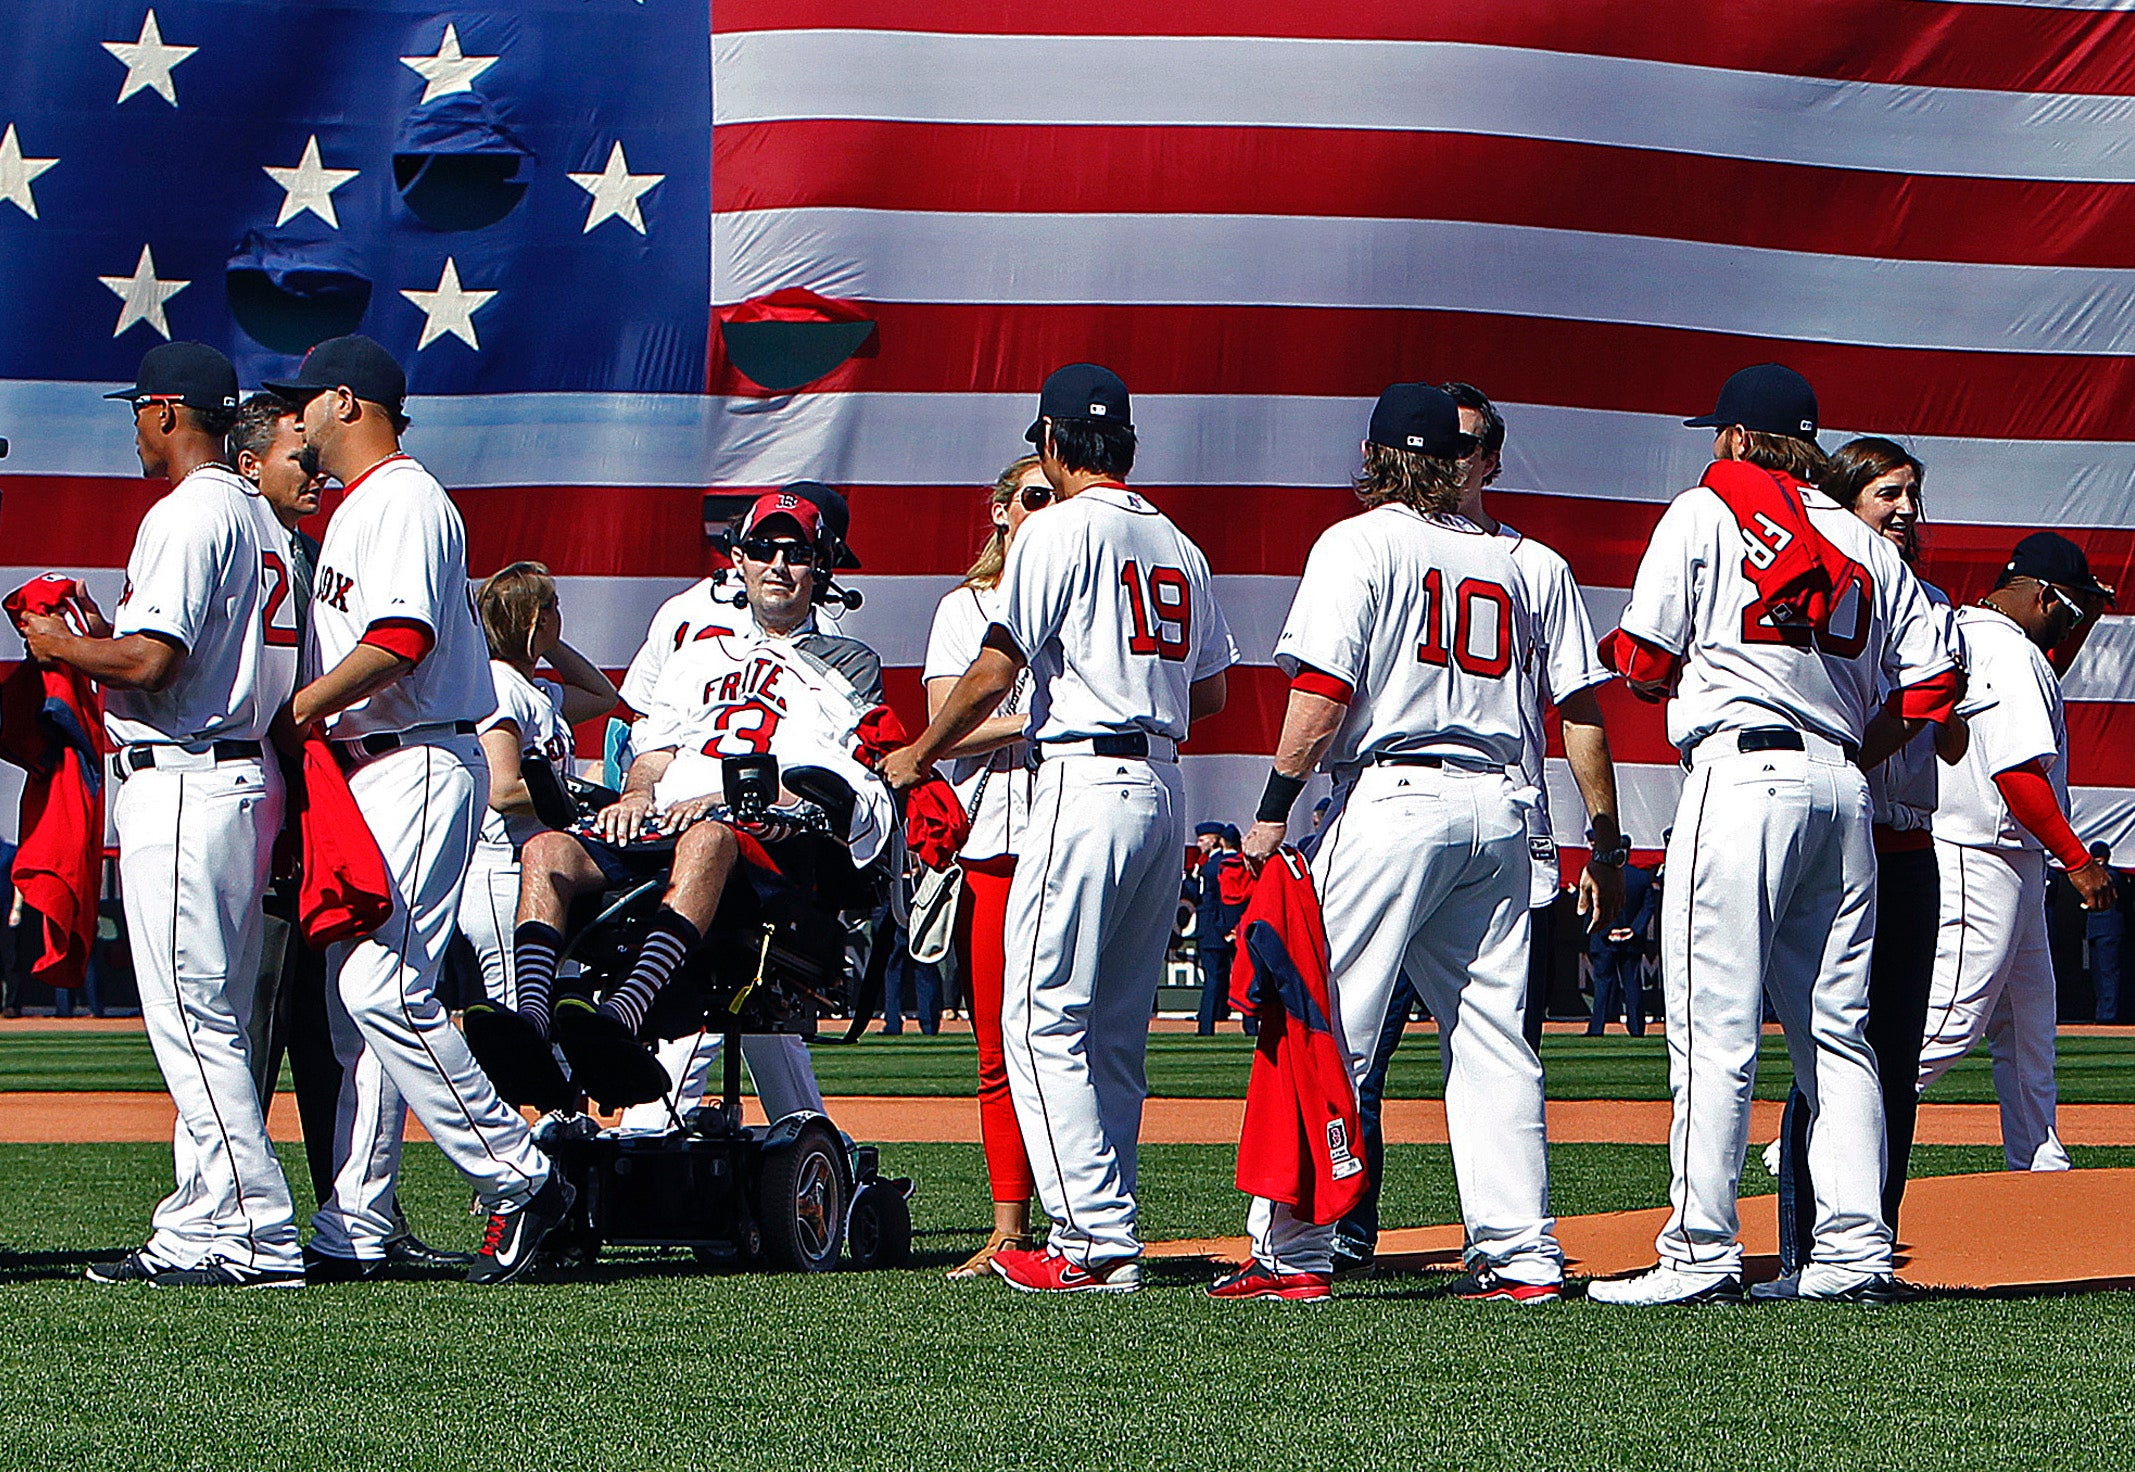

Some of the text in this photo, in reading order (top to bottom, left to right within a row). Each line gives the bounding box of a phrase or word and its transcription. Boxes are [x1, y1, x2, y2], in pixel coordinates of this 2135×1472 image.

[1120, 559, 1192, 663] 19
[1416, 566, 1514, 681] 10
[700, 698, 781, 760] 3
